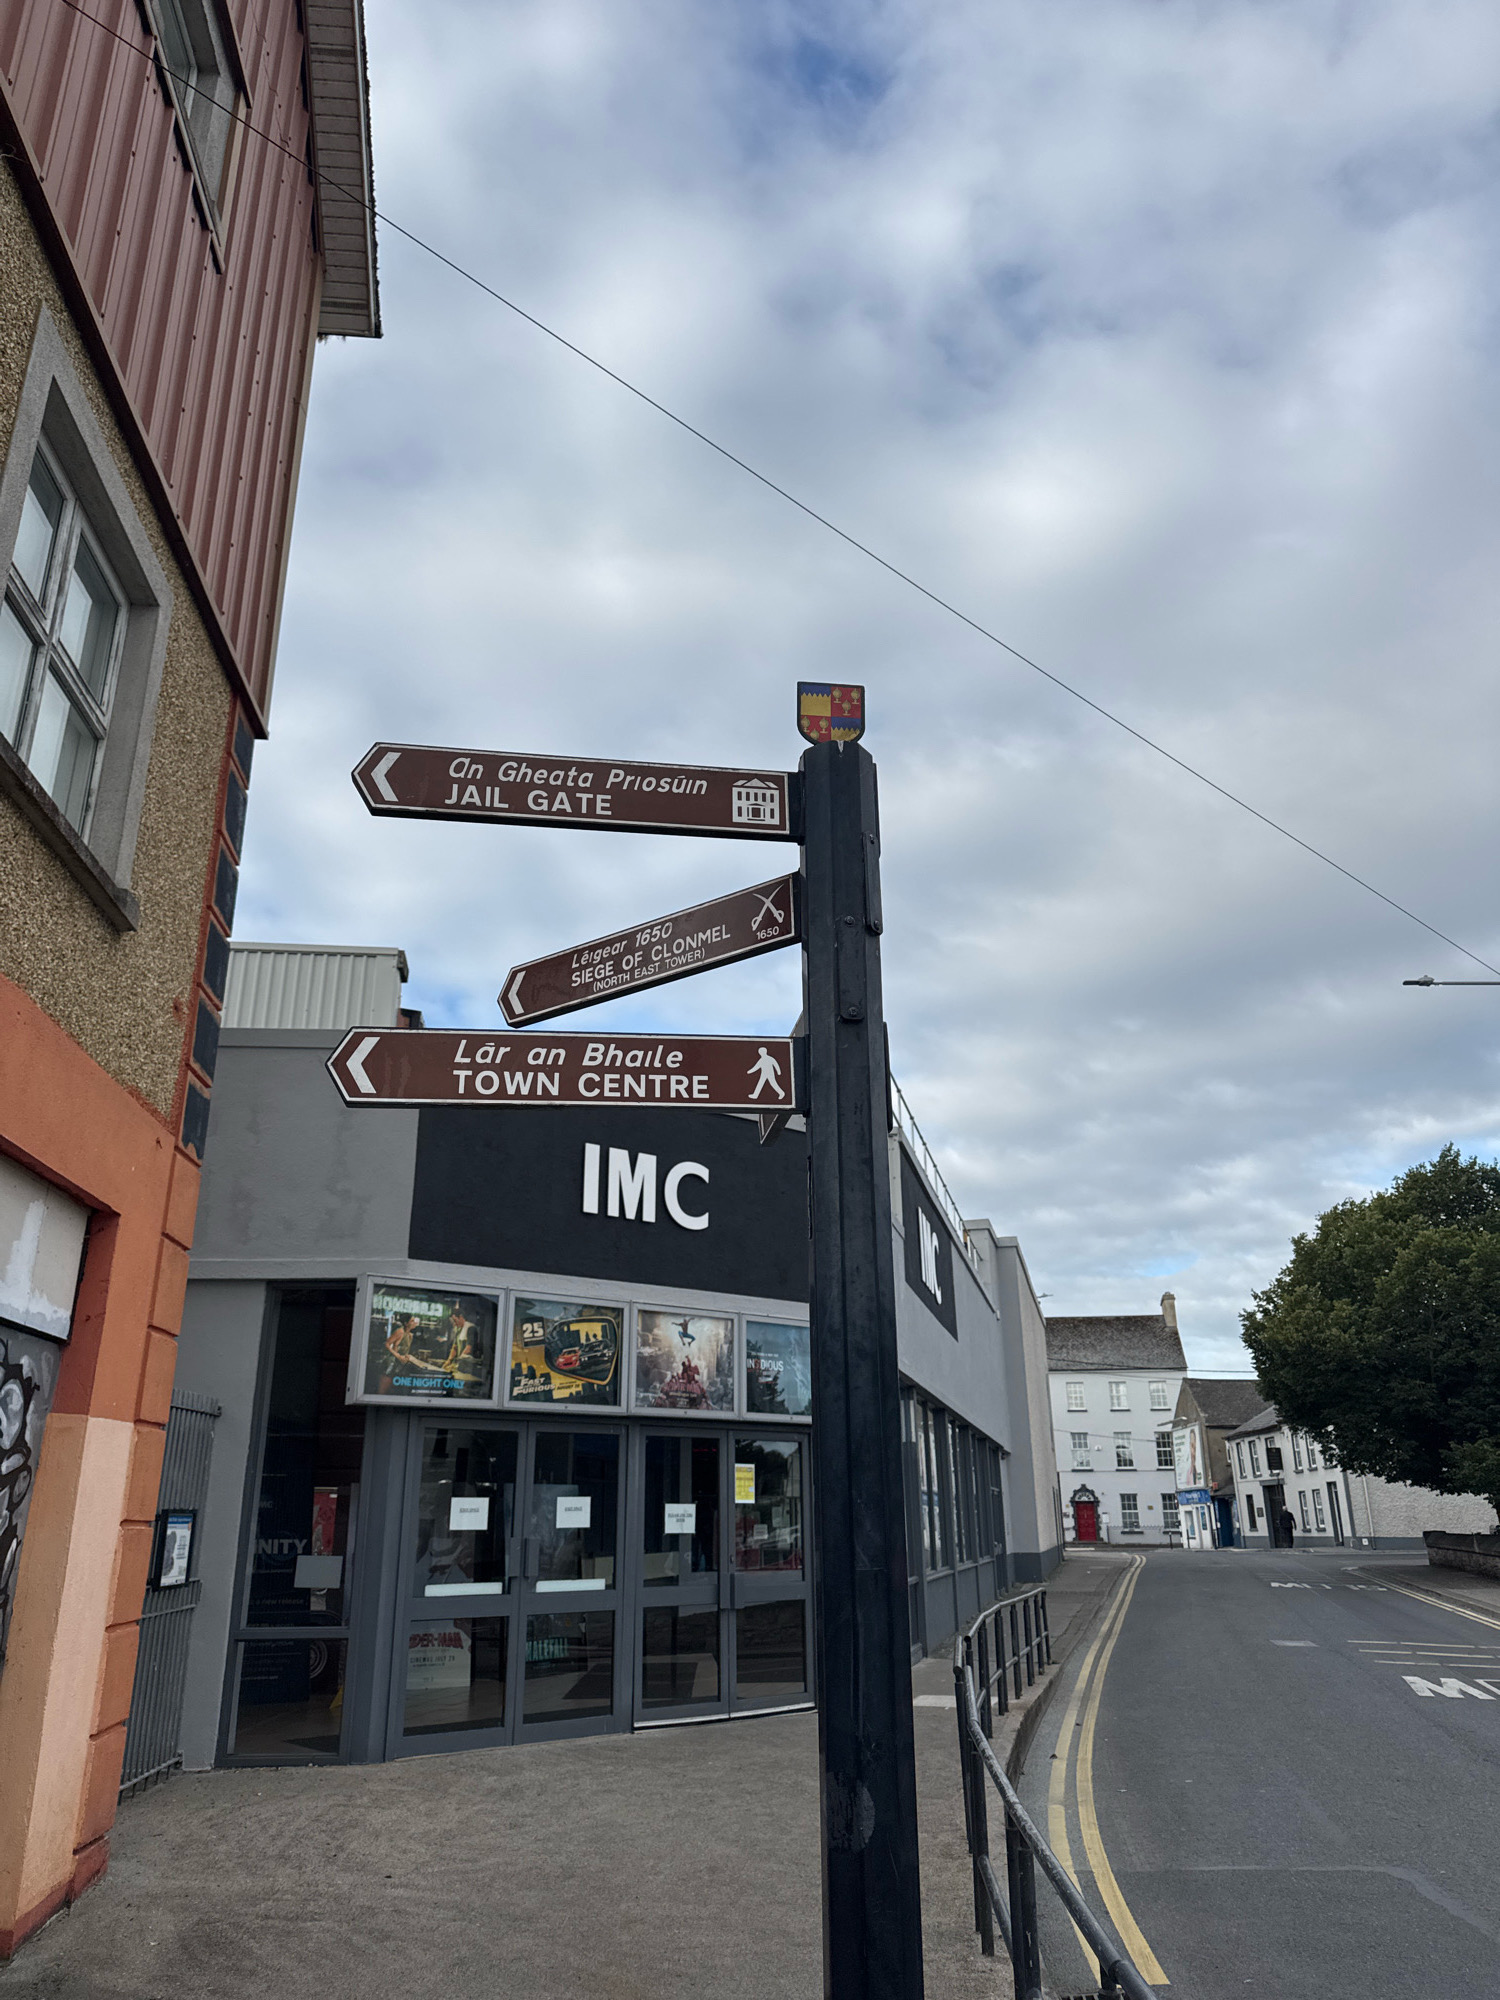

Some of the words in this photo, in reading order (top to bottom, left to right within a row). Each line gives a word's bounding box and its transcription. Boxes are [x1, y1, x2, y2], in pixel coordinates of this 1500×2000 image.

[449, 757, 484, 780] An
[498, 761, 594, 788] Gheata
[445, 784, 509, 808] JAIL
[527, 789, 612, 815] GATE
[635, 922, 673, 948] 1650
[756, 925, 780, 940] 1650
[571, 960, 615, 987] SIEGE
[622, 951, 643, 970] OF
[651, 924, 731, 961] CLONMEL
[593, 972, 630, 993] (NORTH
[634, 962, 660, 979] EAST
[665, 947, 706, 969] TOWER)
[527, 1047, 566, 1065] an
[582, 1042, 683, 1068] Bhaile
[453, 1069, 560, 1096] TOWN
[578, 1072, 710, 1099] CENTRE
[582, 1142, 710, 1231] IMC
[522, 1321, 544, 1338] 25
[392, 1376, 412, 1386] ONE
[412, 1377, 443, 1388] NIGHT
[443, 1378, 465, 1390] ONLY
[512, 1384, 556, 1397] FURIOUS
[521, 1377, 546, 1387] FAST
